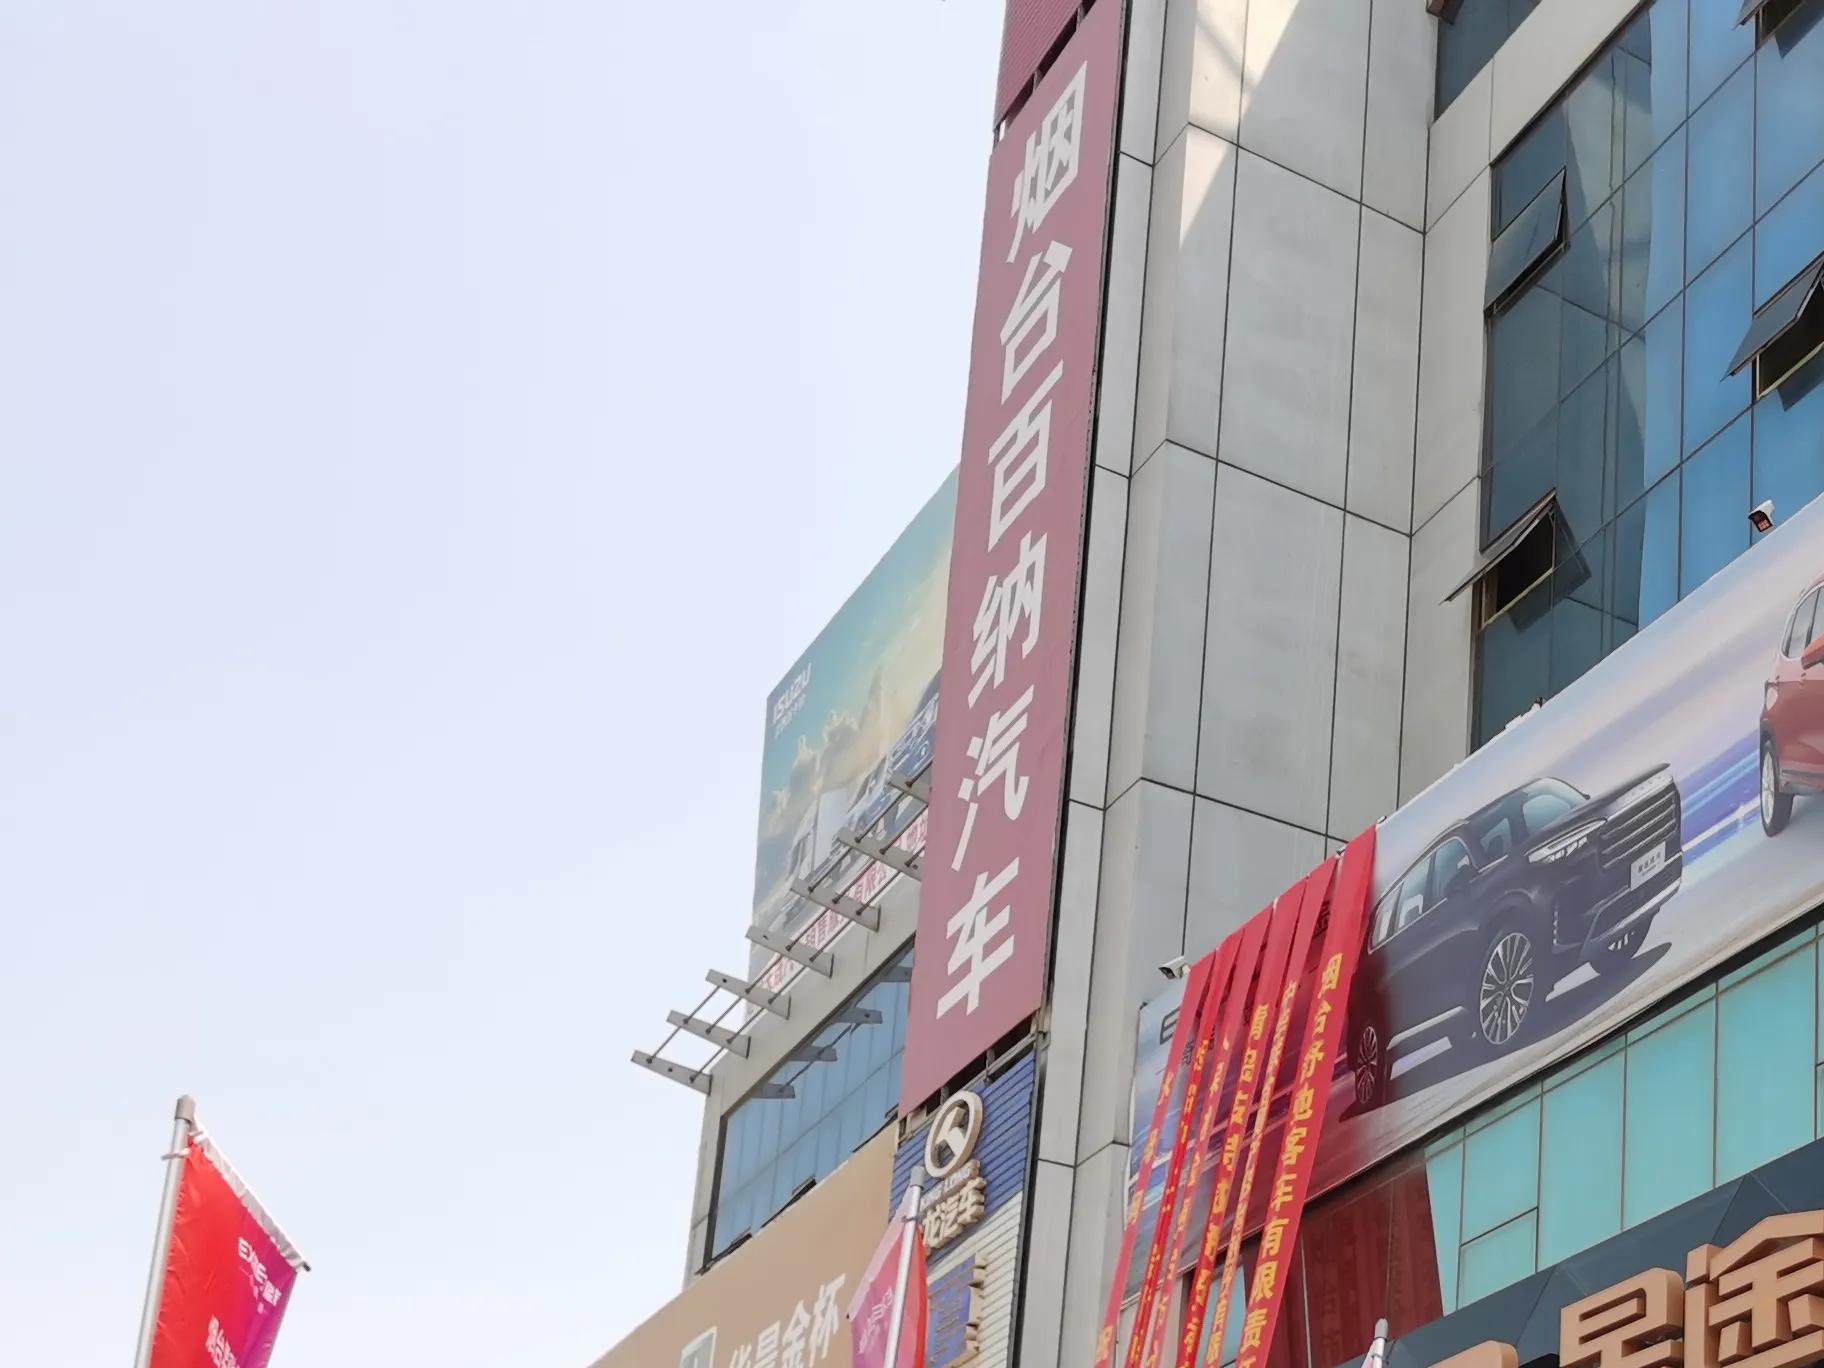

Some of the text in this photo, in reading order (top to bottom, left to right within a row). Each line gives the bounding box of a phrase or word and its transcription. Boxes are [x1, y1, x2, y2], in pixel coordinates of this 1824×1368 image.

[934, 60, 1087, 1019] 烟台百纳汽车
